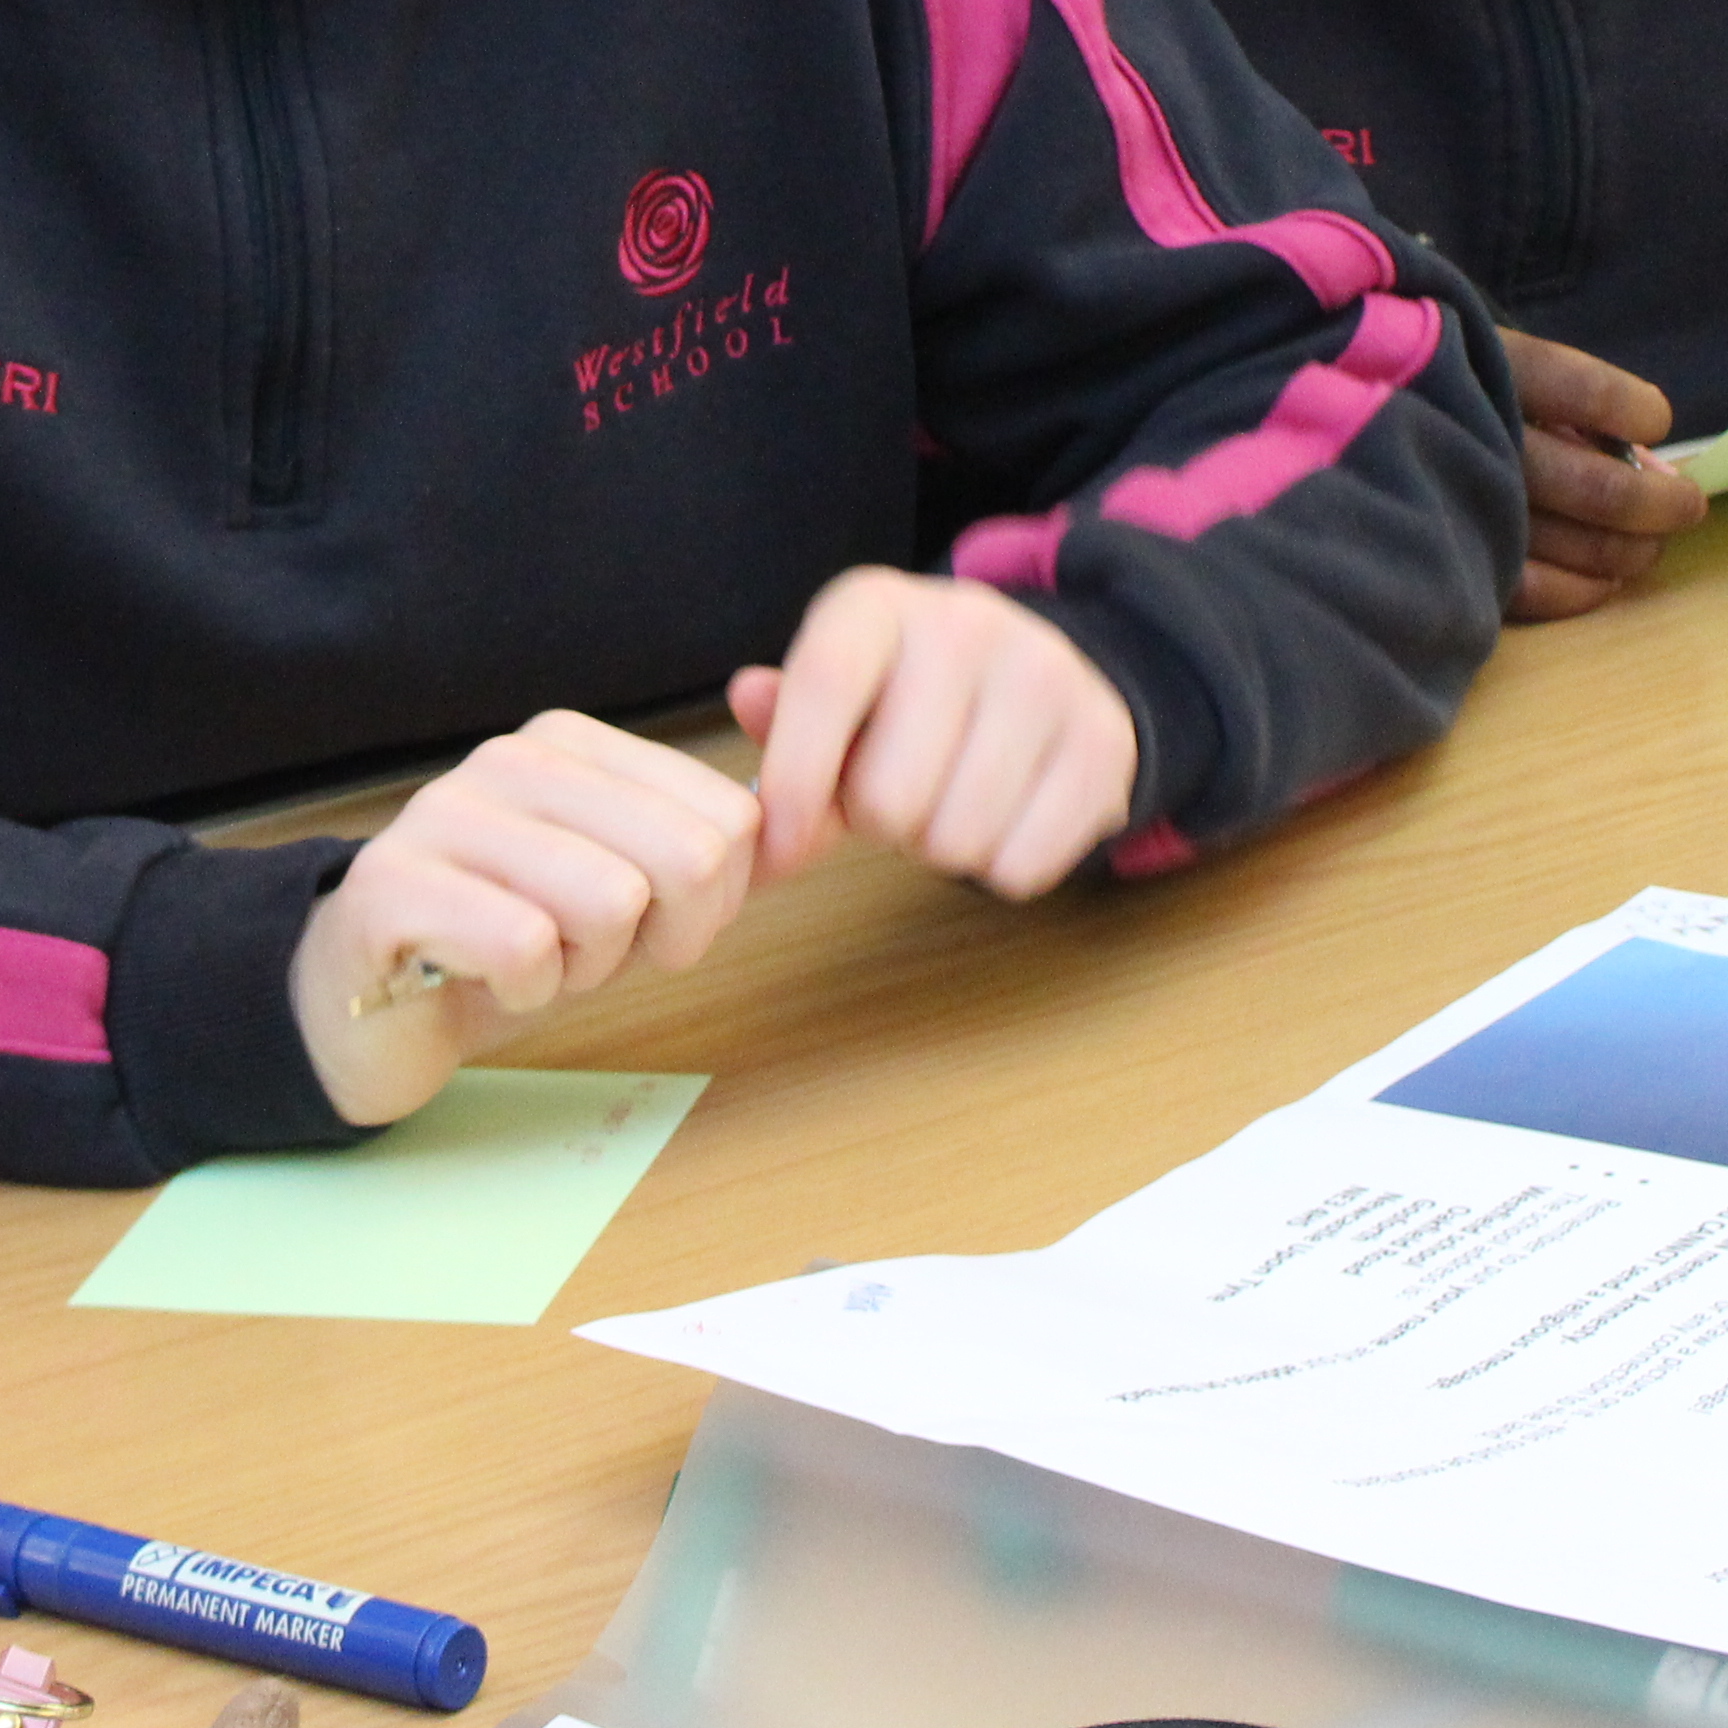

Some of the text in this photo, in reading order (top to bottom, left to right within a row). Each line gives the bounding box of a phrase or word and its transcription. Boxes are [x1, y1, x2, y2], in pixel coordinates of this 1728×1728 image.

[574, 266, 790, 393] Westfield
[583, 316, 793, 431] SCHOOL
[1419, 1284, 1472, 1314] your
[121, 1574, 346, 1653] PERMANENT MARKER
[191, 1557, 316, 1602] IMPEGA
